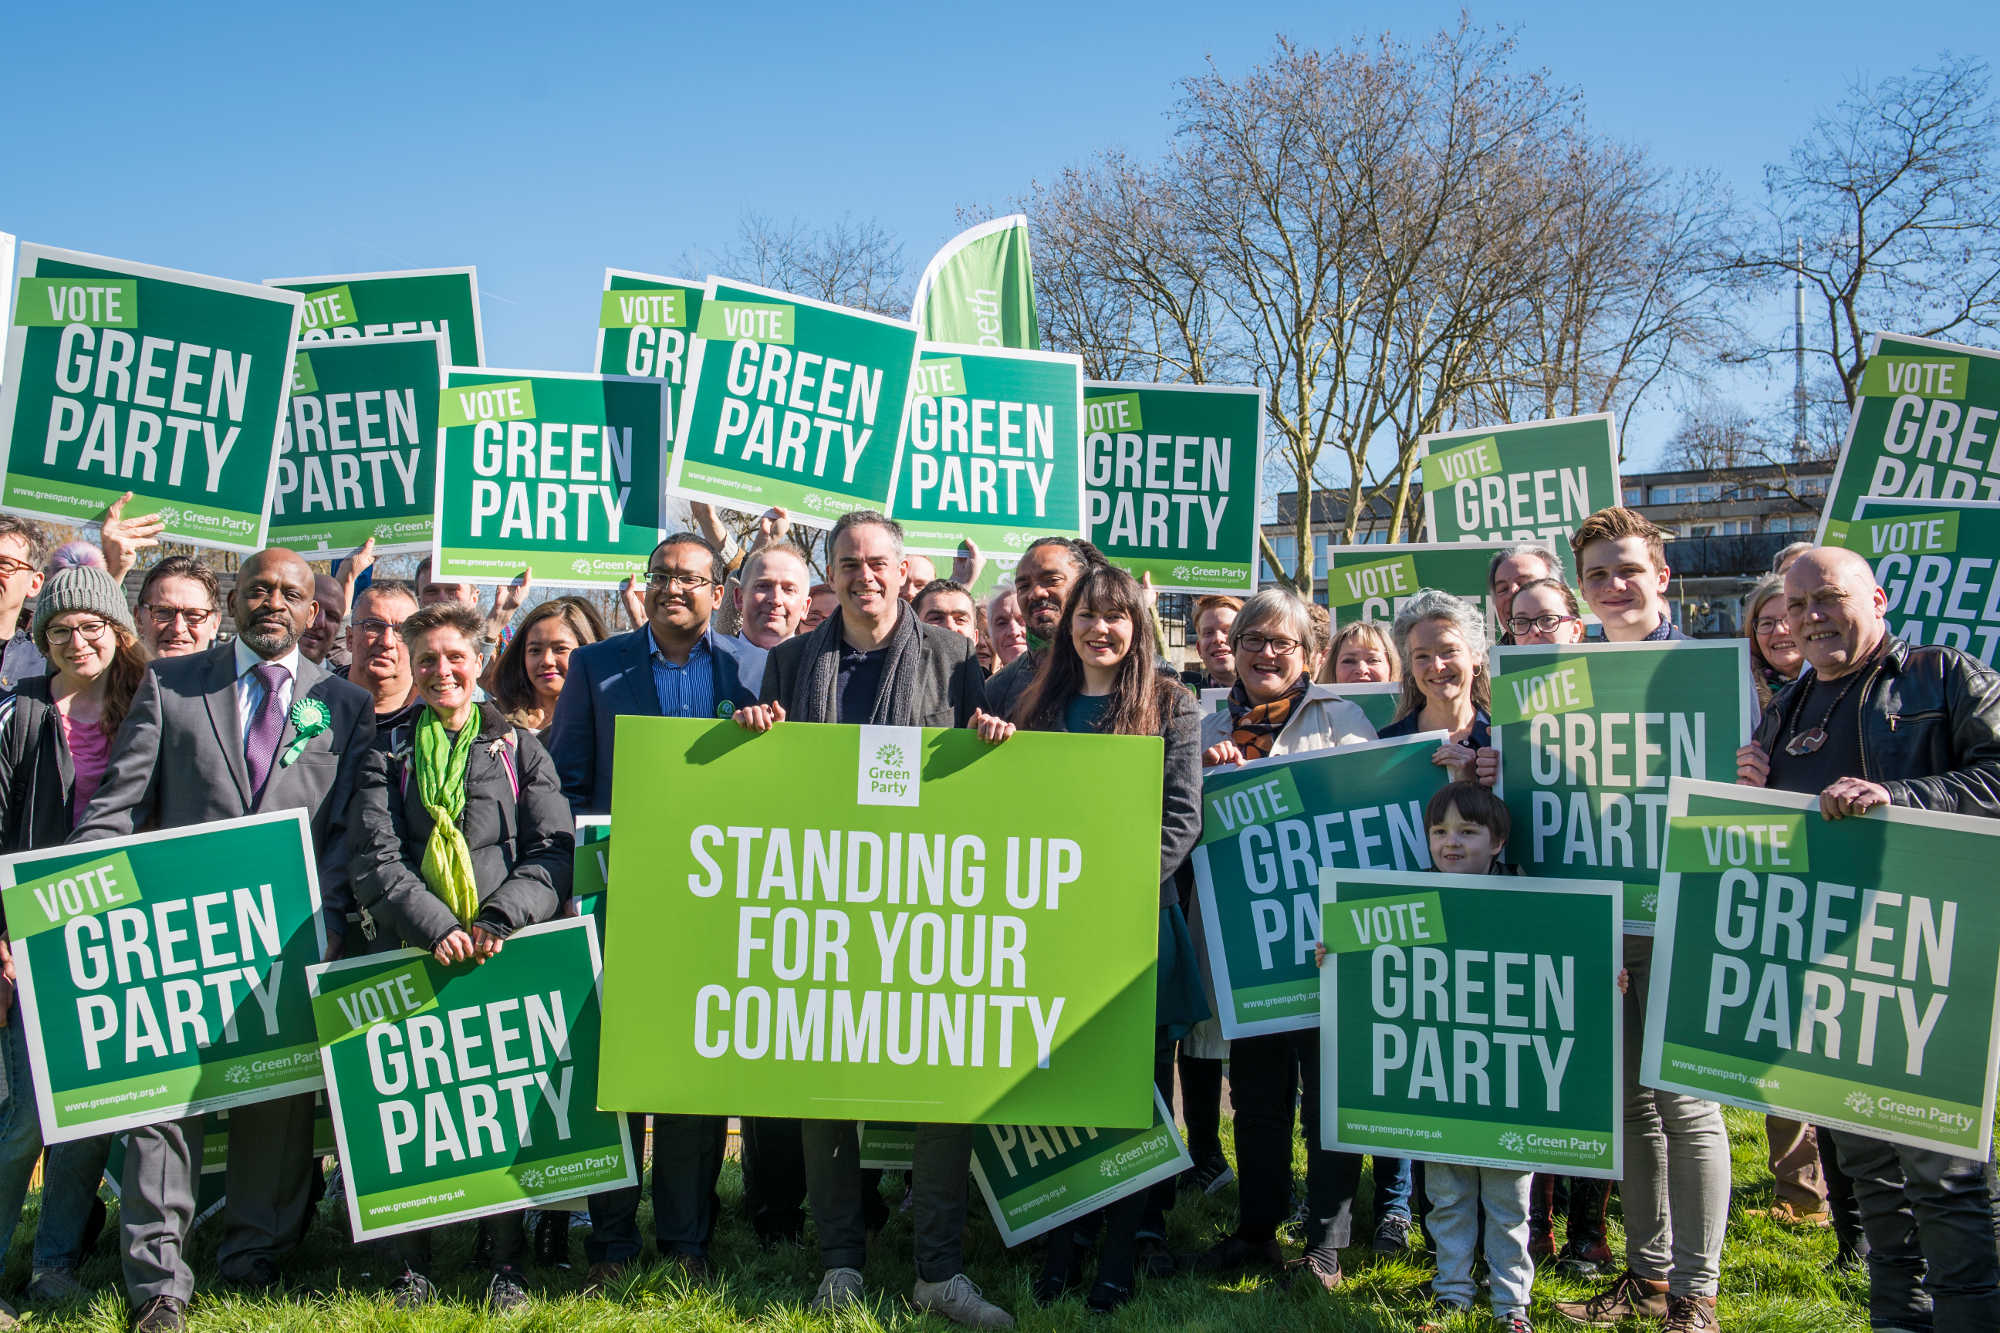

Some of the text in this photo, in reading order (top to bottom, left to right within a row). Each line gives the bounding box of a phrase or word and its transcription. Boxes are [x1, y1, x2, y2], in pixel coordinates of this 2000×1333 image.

[47, 285, 123, 323] VOTE
[302, 293, 346, 328] OTE
[620, 296, 675, 324] VOTE
[724, 308, 783, 340] VOTE
[55, 323, 252, 422] GREEN
[727, 339, 884, 426] GREEN
[914, 364, 955, 394] OTE
[1887, 362, 1956, 395] VOTE
[460, 388, 523, 421] VOTE
[911, 396, 1054, 460] GREEN
[43, 395, 241, 493] PARTY
[473, 420, 632, 482] GREEN
[713, 397, 874, 484] PARTY
[1086, 432, 1231, 492] GREEN
[1884, 395, 2000, 474] GRE
[273, 448, 421, 515] PARTY
[912, 454, 1054, 517] PARTY
[1438, 445, 1491, 483] VOTE
[13, 487, 105, 509] www.greenparty.org.uk
[183, 510, 219, 526] Green
[222, 516, 255, 534] Party
[471, 481, 631, 543] PARTY
[1086, 490, 1228, 550] PARTY
[1455, 466, 1590, 531] GREEN
[1871, 519, 1944, 553] VOTE
[626, 560, 648, 571] Part
[1192, 566, 1220, 577] Green
[1222, 567, 1248, 580] Party
[1345, 562, 1407, 599] VOTE
[1874, 553, 2000, 621] GRE
[1512, 673, 1579, 714] VOTE
[869, 767, 910, 780] Green
[1530, 712, 1706, 787] GREEN
[871, 781, 907, 797] Party
[1212, 779, 1290, 831] VOTE
[1239, 800, 1432, 896] GREEN
[1532, 791, 1667, 869] PART
[1702, 824, 1790, 866] VOTE
[33, 864, 124, 923] VOTE
[688, 824, 986, 907] STANDING
[1006, 837, 1083, 910] UP
[64, 884, 281, 990] GREEN
[737, 906, 1028, 988] FOR YOUR
[1350, 902, 1430, 945] VOTE
[1714, 868, 1958, 988] GREEN
[76, 960, 284, 1071] PARTY
[337, 973, 421, 1030] VOTE
[1371, 945, 1575, 1031] GREEN
[1704, 953, 1949, 1076] PARTY
[366, 990, 572, 1096] GREEN
[694, 984, 1065, 1069] COMMUNITY
[251, 1057, 291, 1073] Green
[294, 1049, 320, 1065] Part
[1372, 1023, 1575, 1112] PARTY
[1671, 1057, 1780, 1089] www.greenparty.org.uk
[64, 1084, 168, 1113] www.greenparty.org.uk
[378, 1066, 574, 1175] PARTY
[1878, 1097, 1926, 1119] Green
[1929, 1107, 1974, 1131] Party
[1115, 1146, 1144, 1165] Green
[1142, 1135, 1168, 1153] Party
[1346, 1122, 1443, 1139] www.greenparty.org.uk
[1526, 1133, 1607, 1156] Green Party
[545, 1154, 619, 1177] Green Party
[369, 1188, 465, 1216] www.greenparty.org.uk
